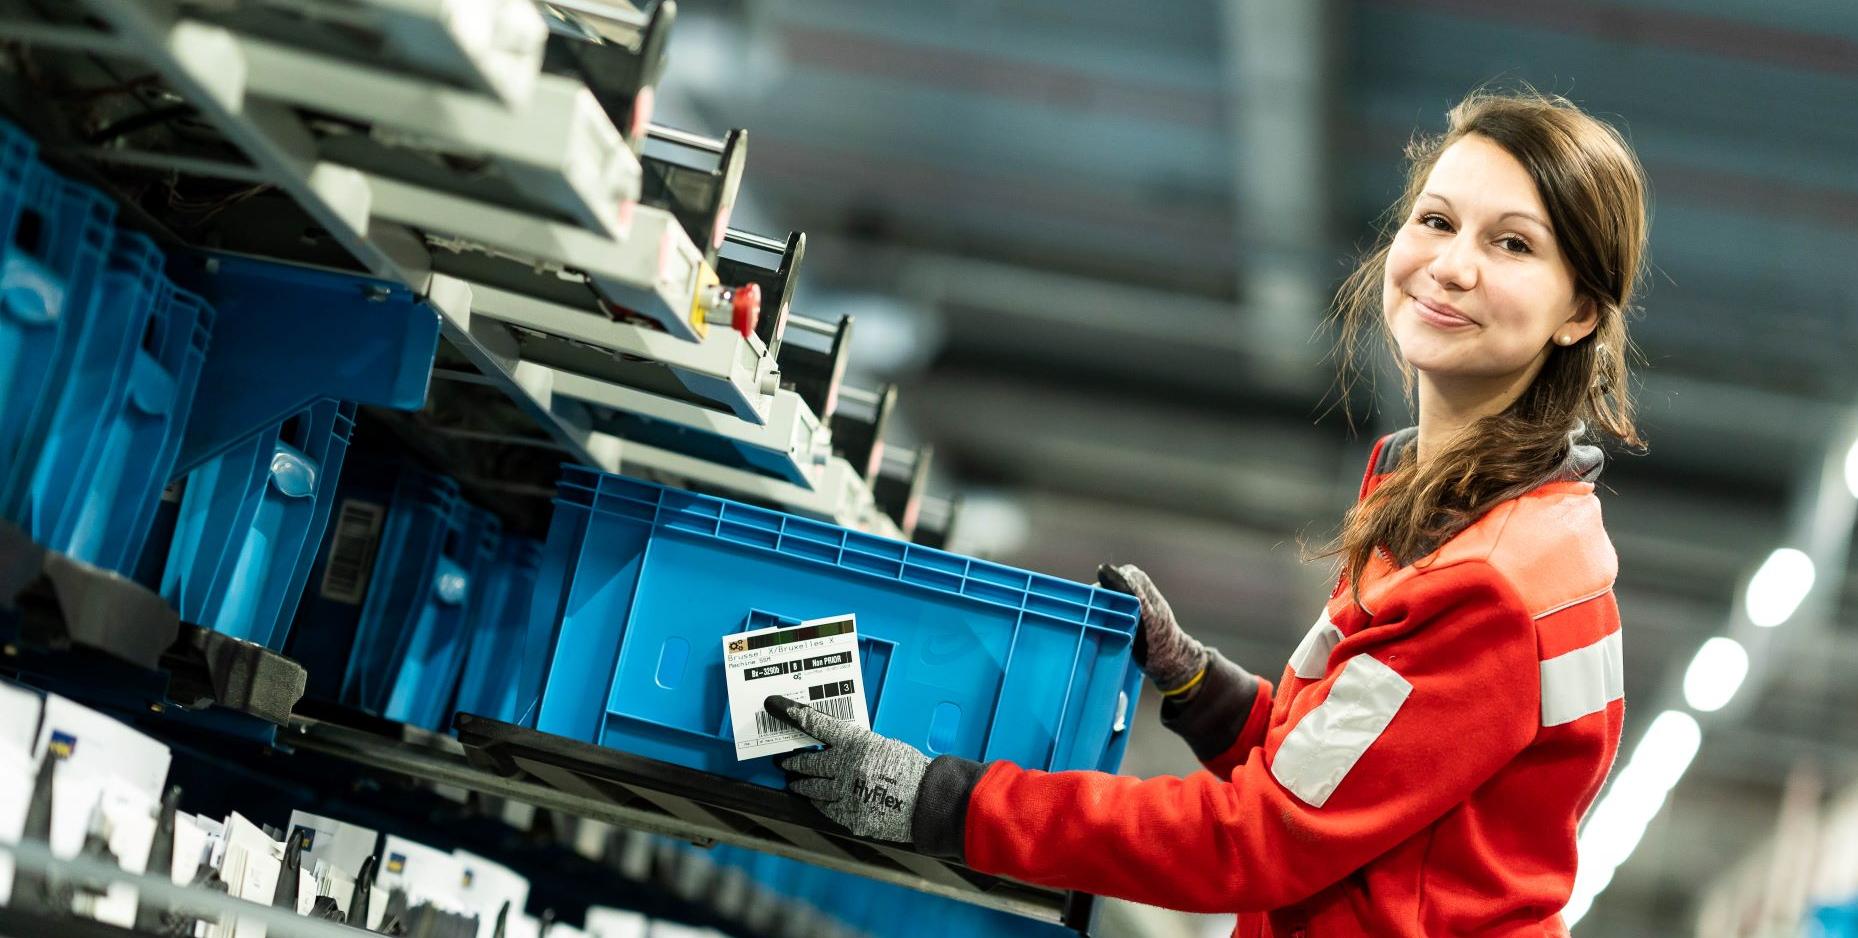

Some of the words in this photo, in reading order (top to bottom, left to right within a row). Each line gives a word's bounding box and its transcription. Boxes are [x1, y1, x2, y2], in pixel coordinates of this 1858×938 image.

[728, 649, 762, 662] Brussel
[769, 640, 824, 654] X/Bruxelles
[728, 659, 756, 669] Machine
[812, 658, 823, 667] Non
[823, 655, 842, 666] PRIOR
[843, 683, 850, 692] 3
[852, 778, 903, 812] HyFlex
